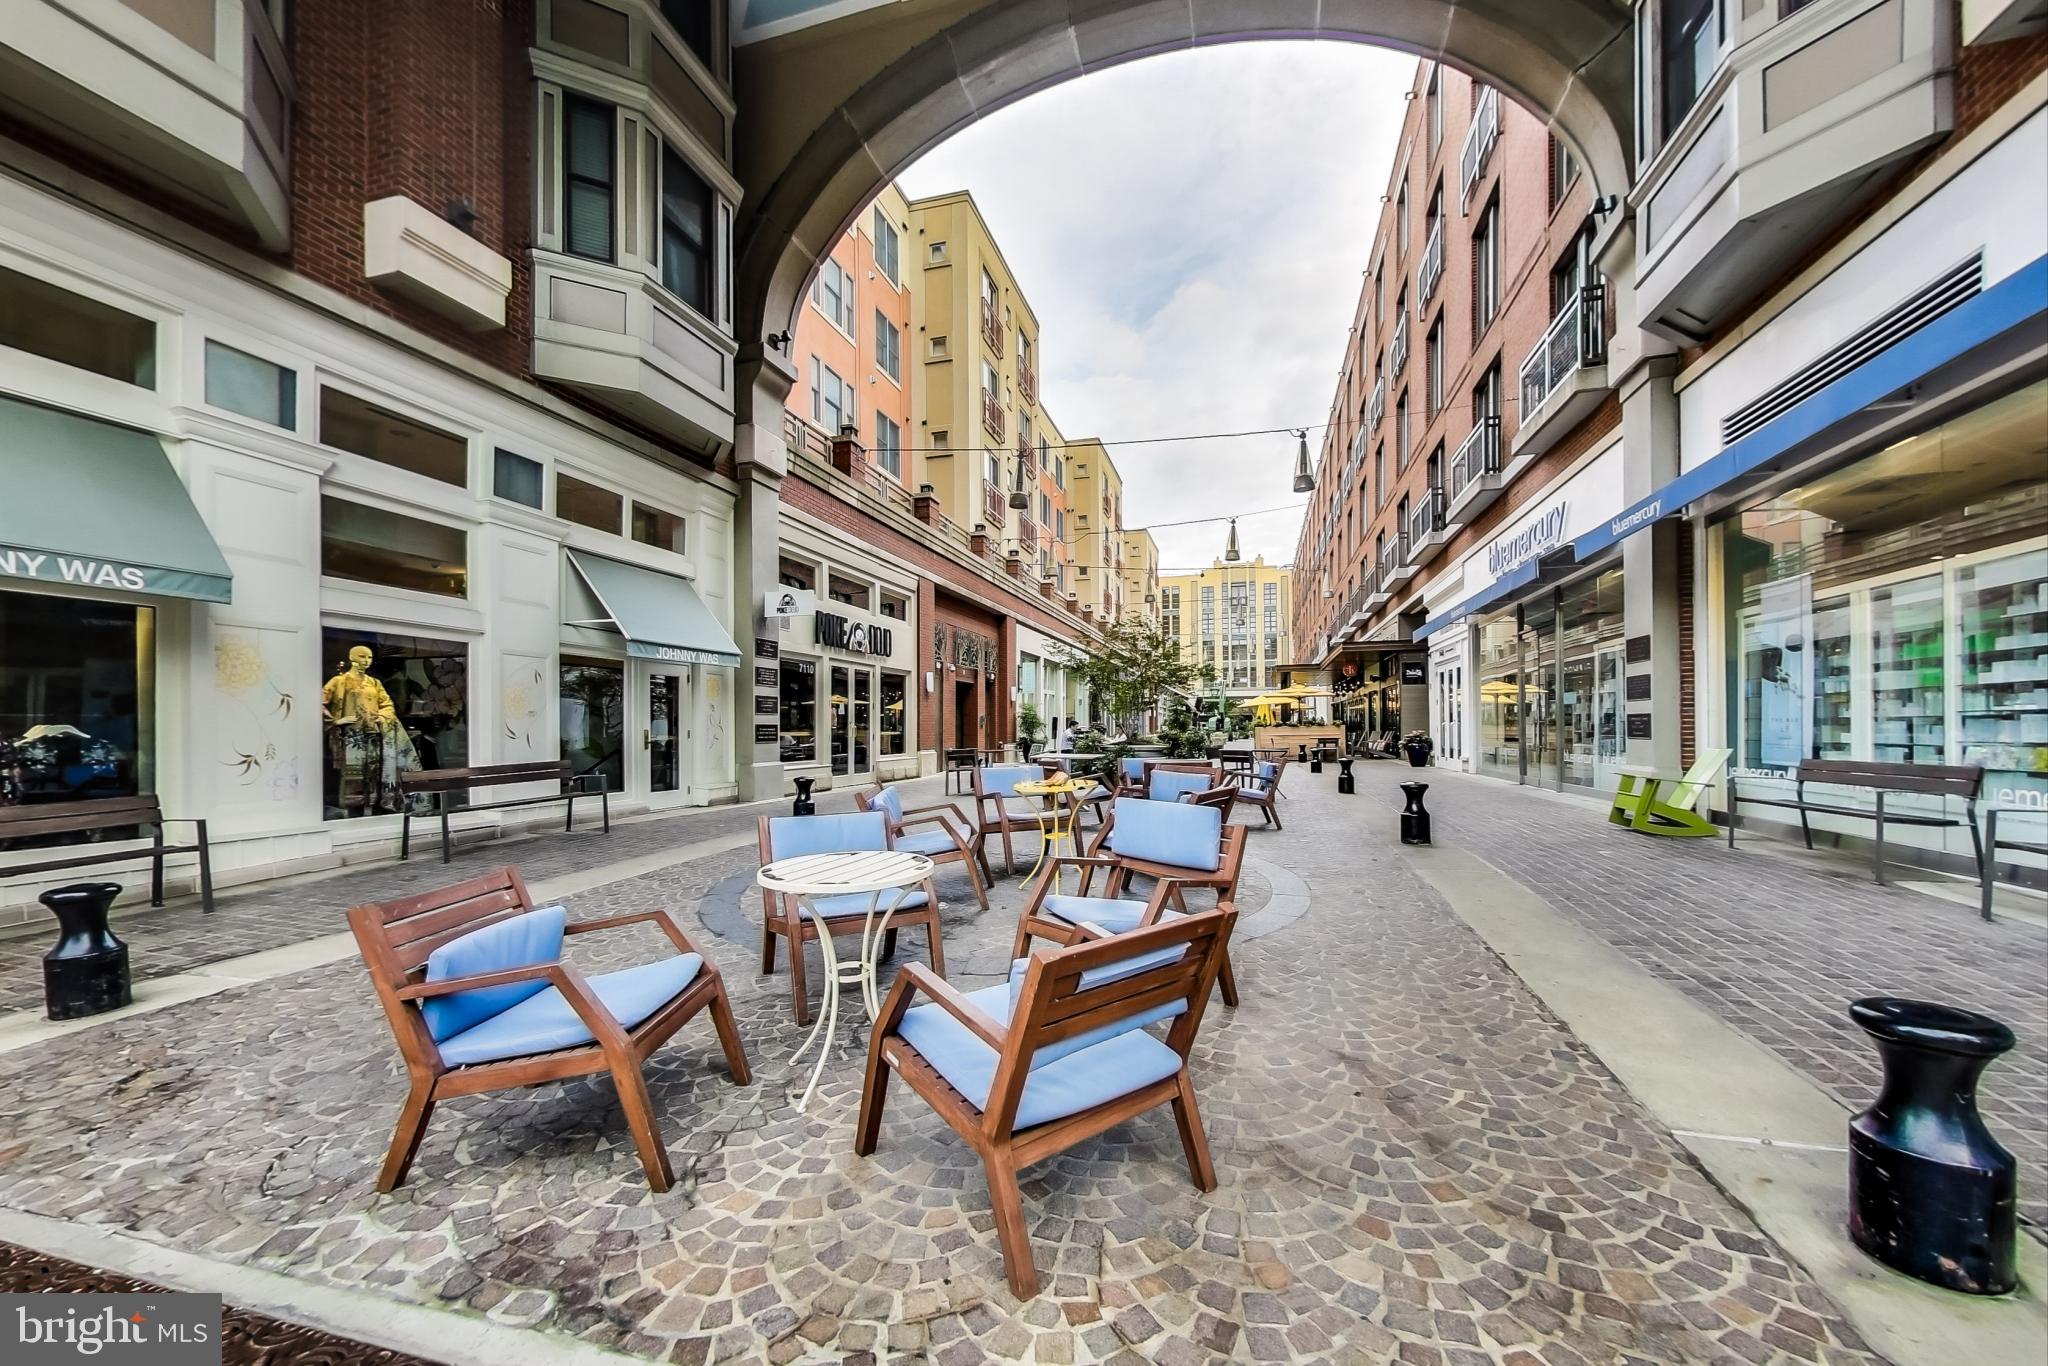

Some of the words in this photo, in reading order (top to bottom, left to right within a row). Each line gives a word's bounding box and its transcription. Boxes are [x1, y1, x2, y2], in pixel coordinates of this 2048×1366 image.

[1611, 499, 1661, 536] bluemercury
[1488, 501, 1567, 575] bluemercury
[56, 557, 146, 590] WAS
[815, 609, 849, 650] POKE
[868, 623, 892, 658] DOJO
[656, 646, 697, 662] JOHNNY
[699, 651, 720, 665] WAS
